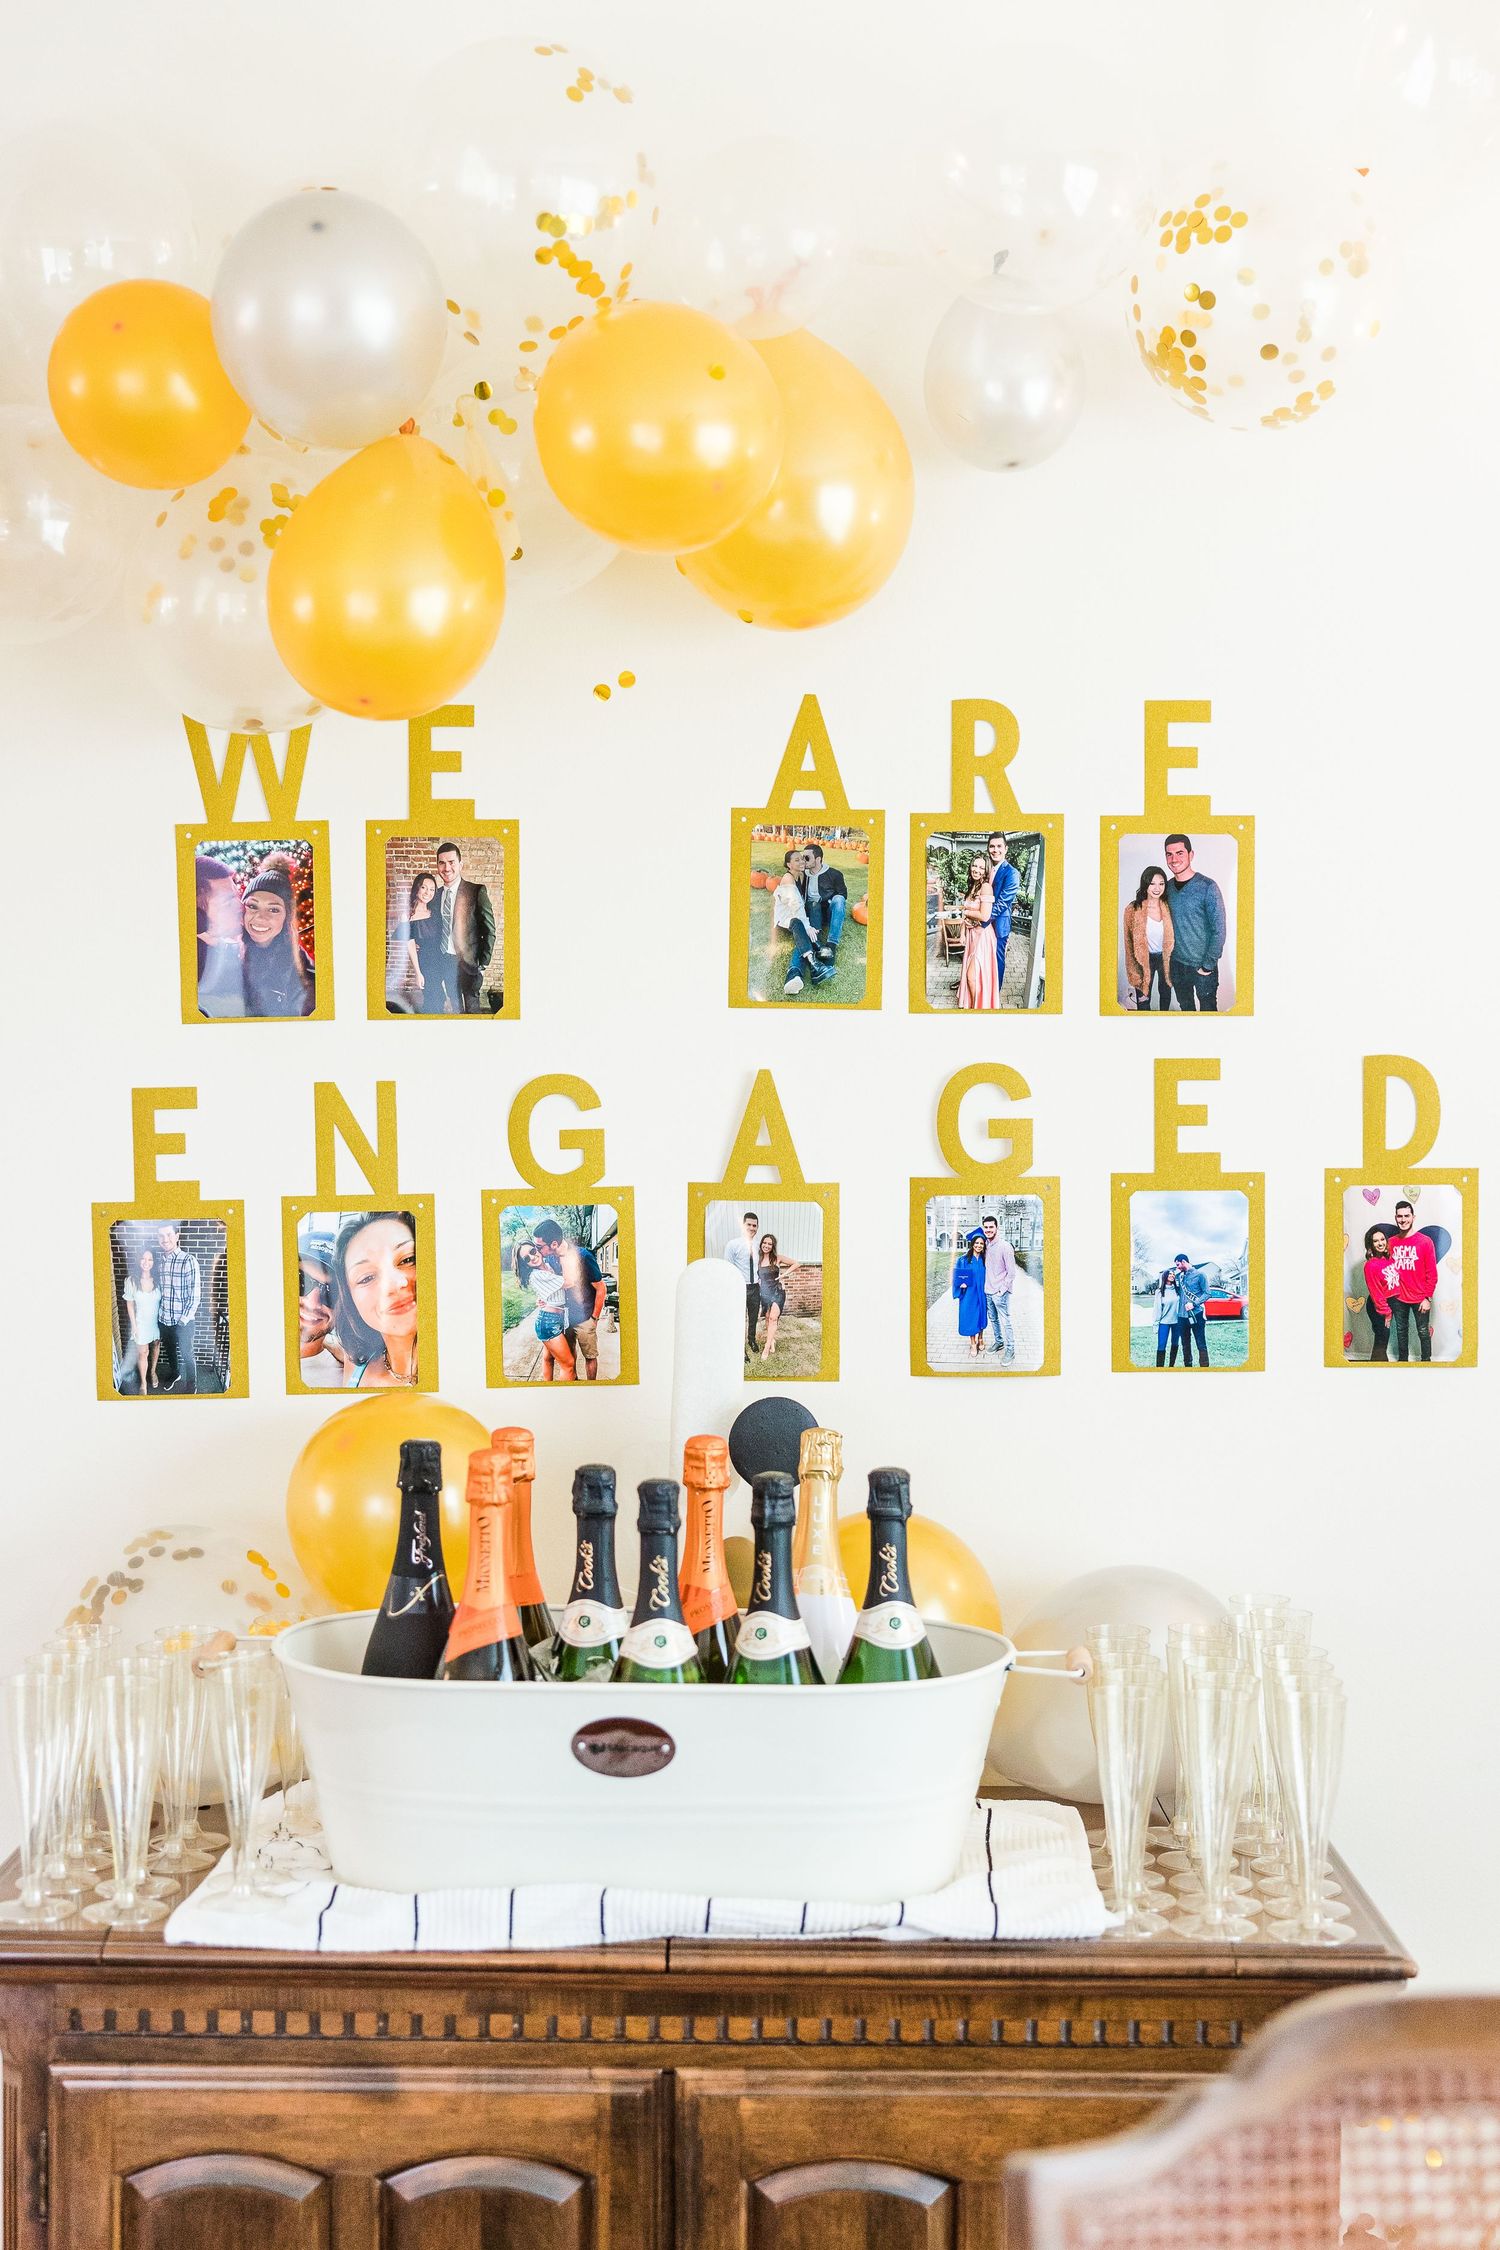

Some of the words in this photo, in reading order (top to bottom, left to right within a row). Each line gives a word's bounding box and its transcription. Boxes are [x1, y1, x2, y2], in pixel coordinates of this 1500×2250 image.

[181, 704, 476, 824] WE
[765, 694, 1212, 815] ARE
[131, 1055, 1442, 1201] ENGAGED
[1392, 1245, 1419, 1260] SIGMA
